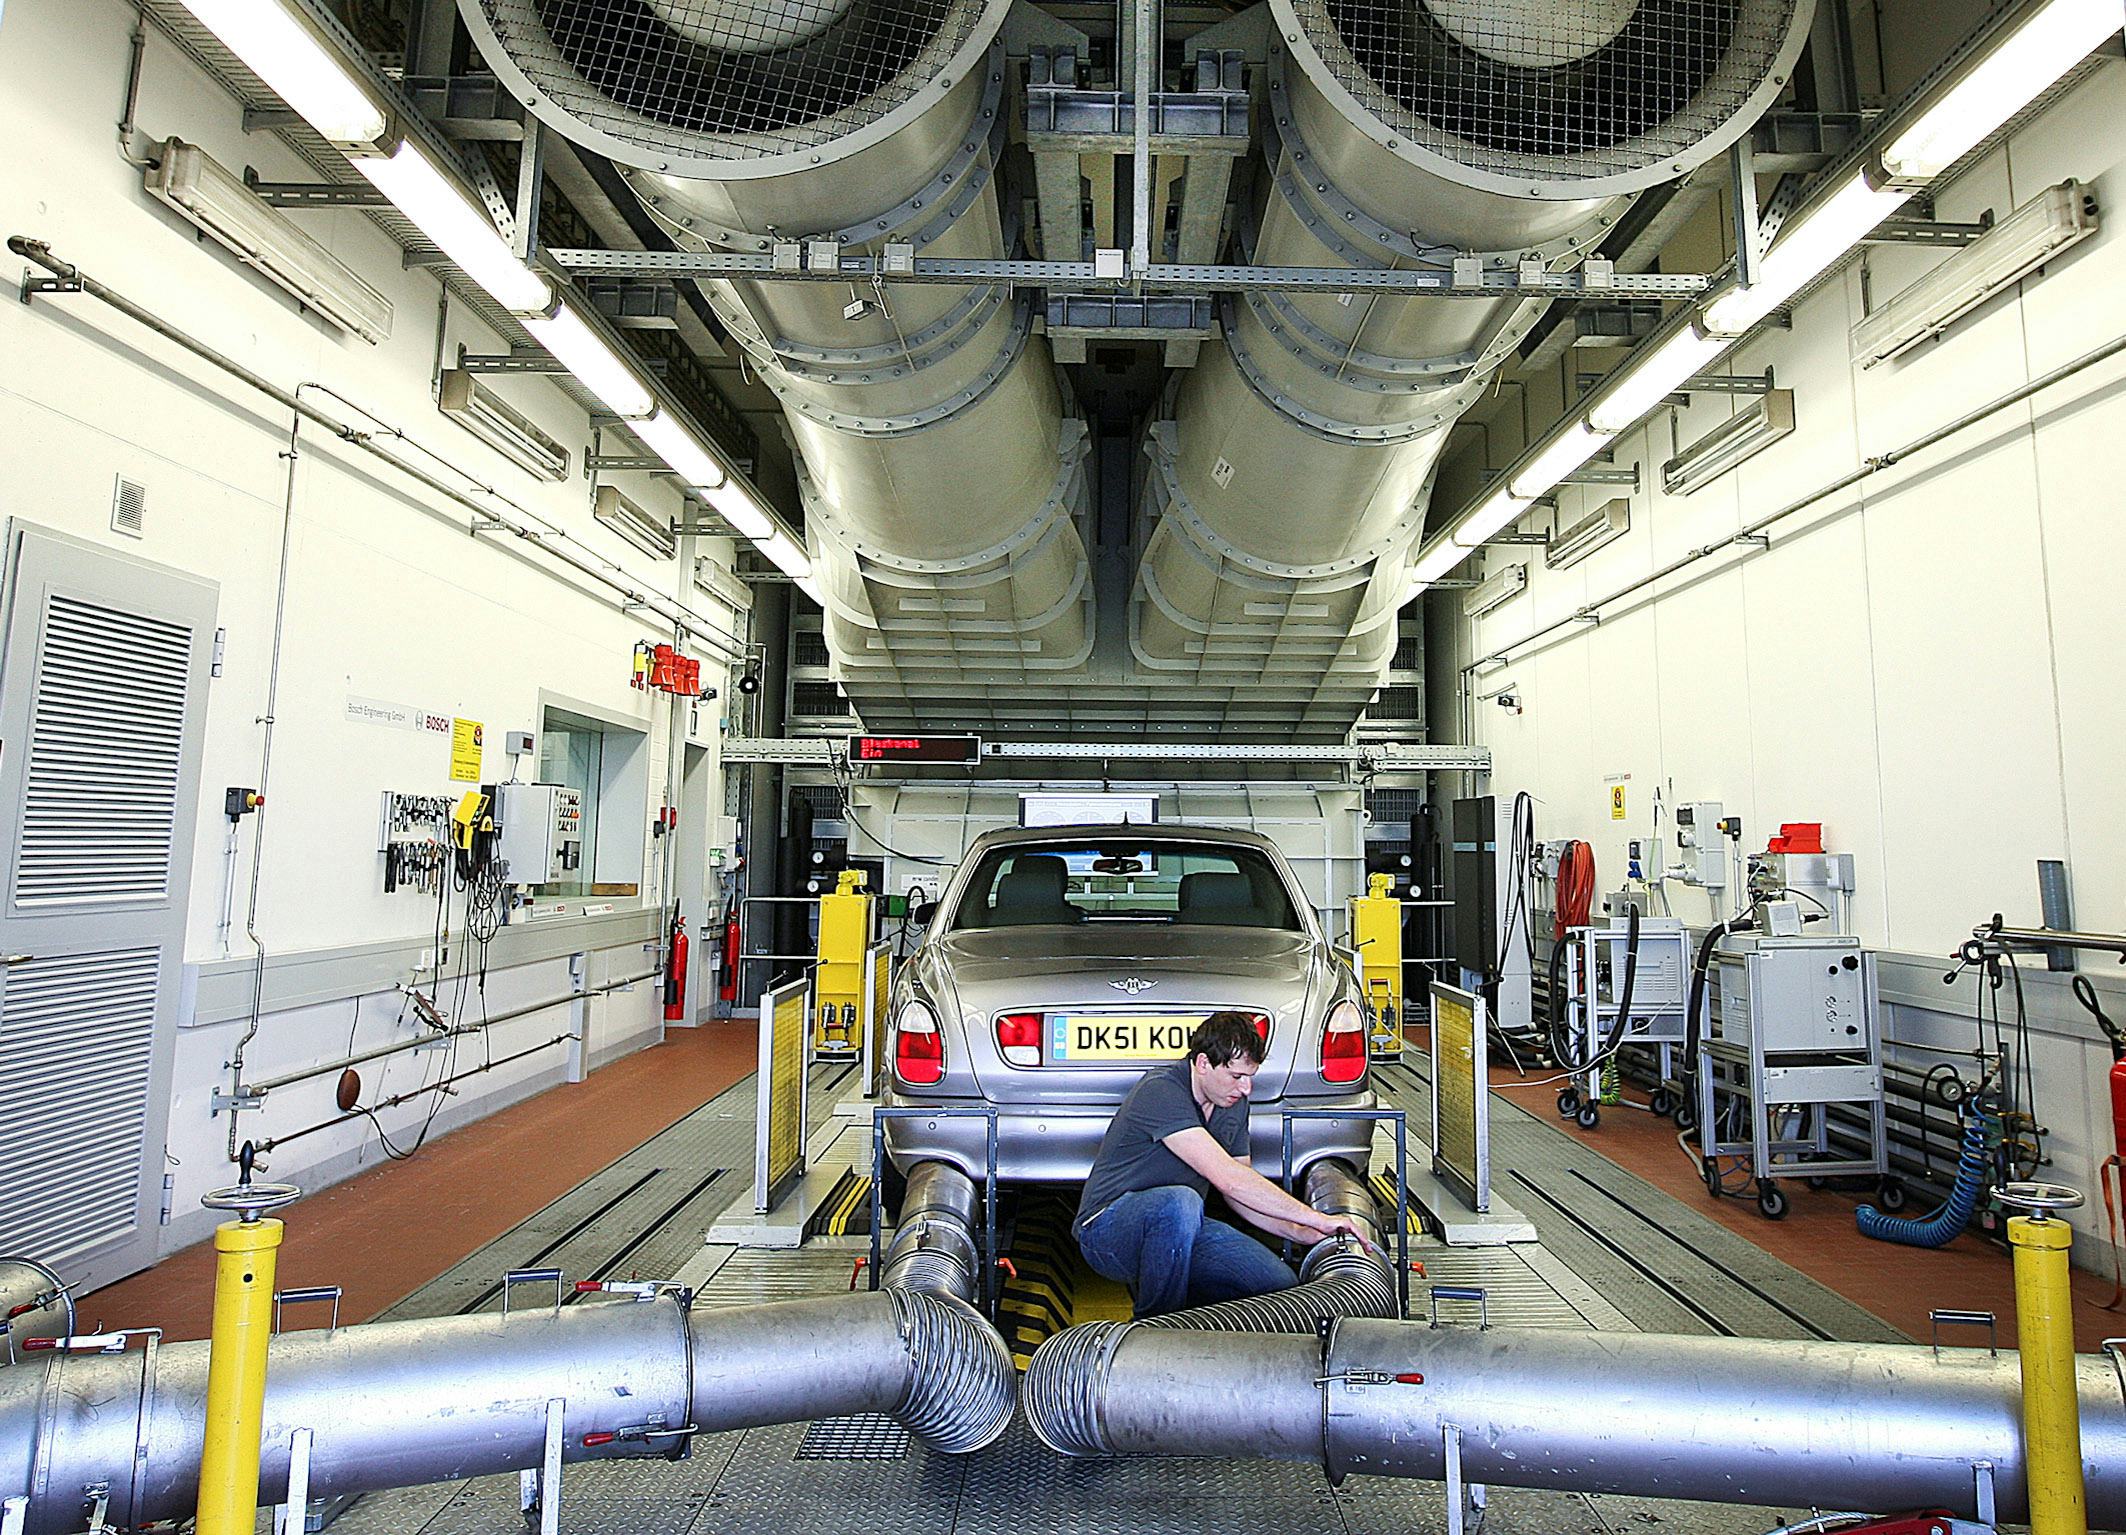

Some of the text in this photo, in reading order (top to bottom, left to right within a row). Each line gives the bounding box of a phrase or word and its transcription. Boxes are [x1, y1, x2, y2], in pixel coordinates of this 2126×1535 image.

[348, 703, 363, 714] Bosch
[426, 715, 450, 733] BOSCH
[1077, 1026, 1138, 1050] DK51
